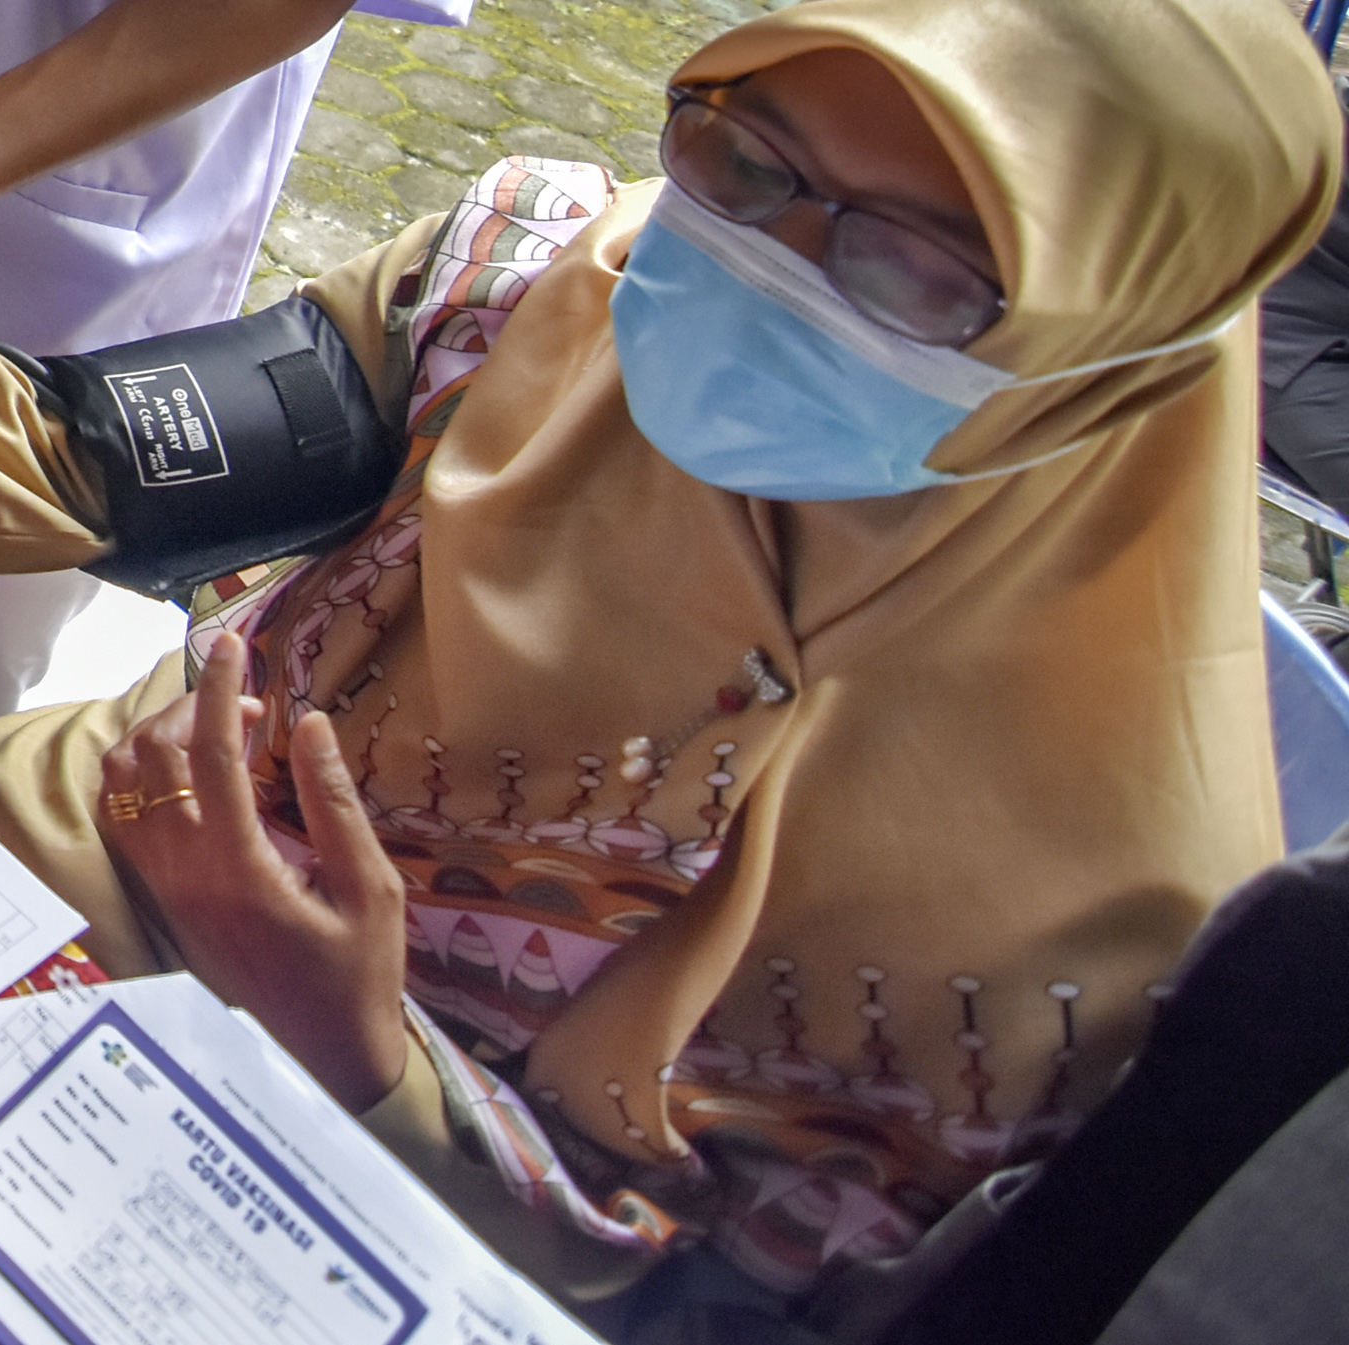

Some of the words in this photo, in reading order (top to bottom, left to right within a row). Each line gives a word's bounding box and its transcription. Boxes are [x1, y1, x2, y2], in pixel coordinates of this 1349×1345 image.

[124, 386, 137, 403] ARM
[132, 385, 147, 403] LEFT
[153, 396, 184, 451] ARTERY
[154, 443, 169, 469] RIGHT
[166, 1105, 229, 1168] KARTU
[220, 1159, 318, 1254] VAKSINASI
[184, 1151, 244, 1211] COVID
[239, 1206, 270, 1238] 19
